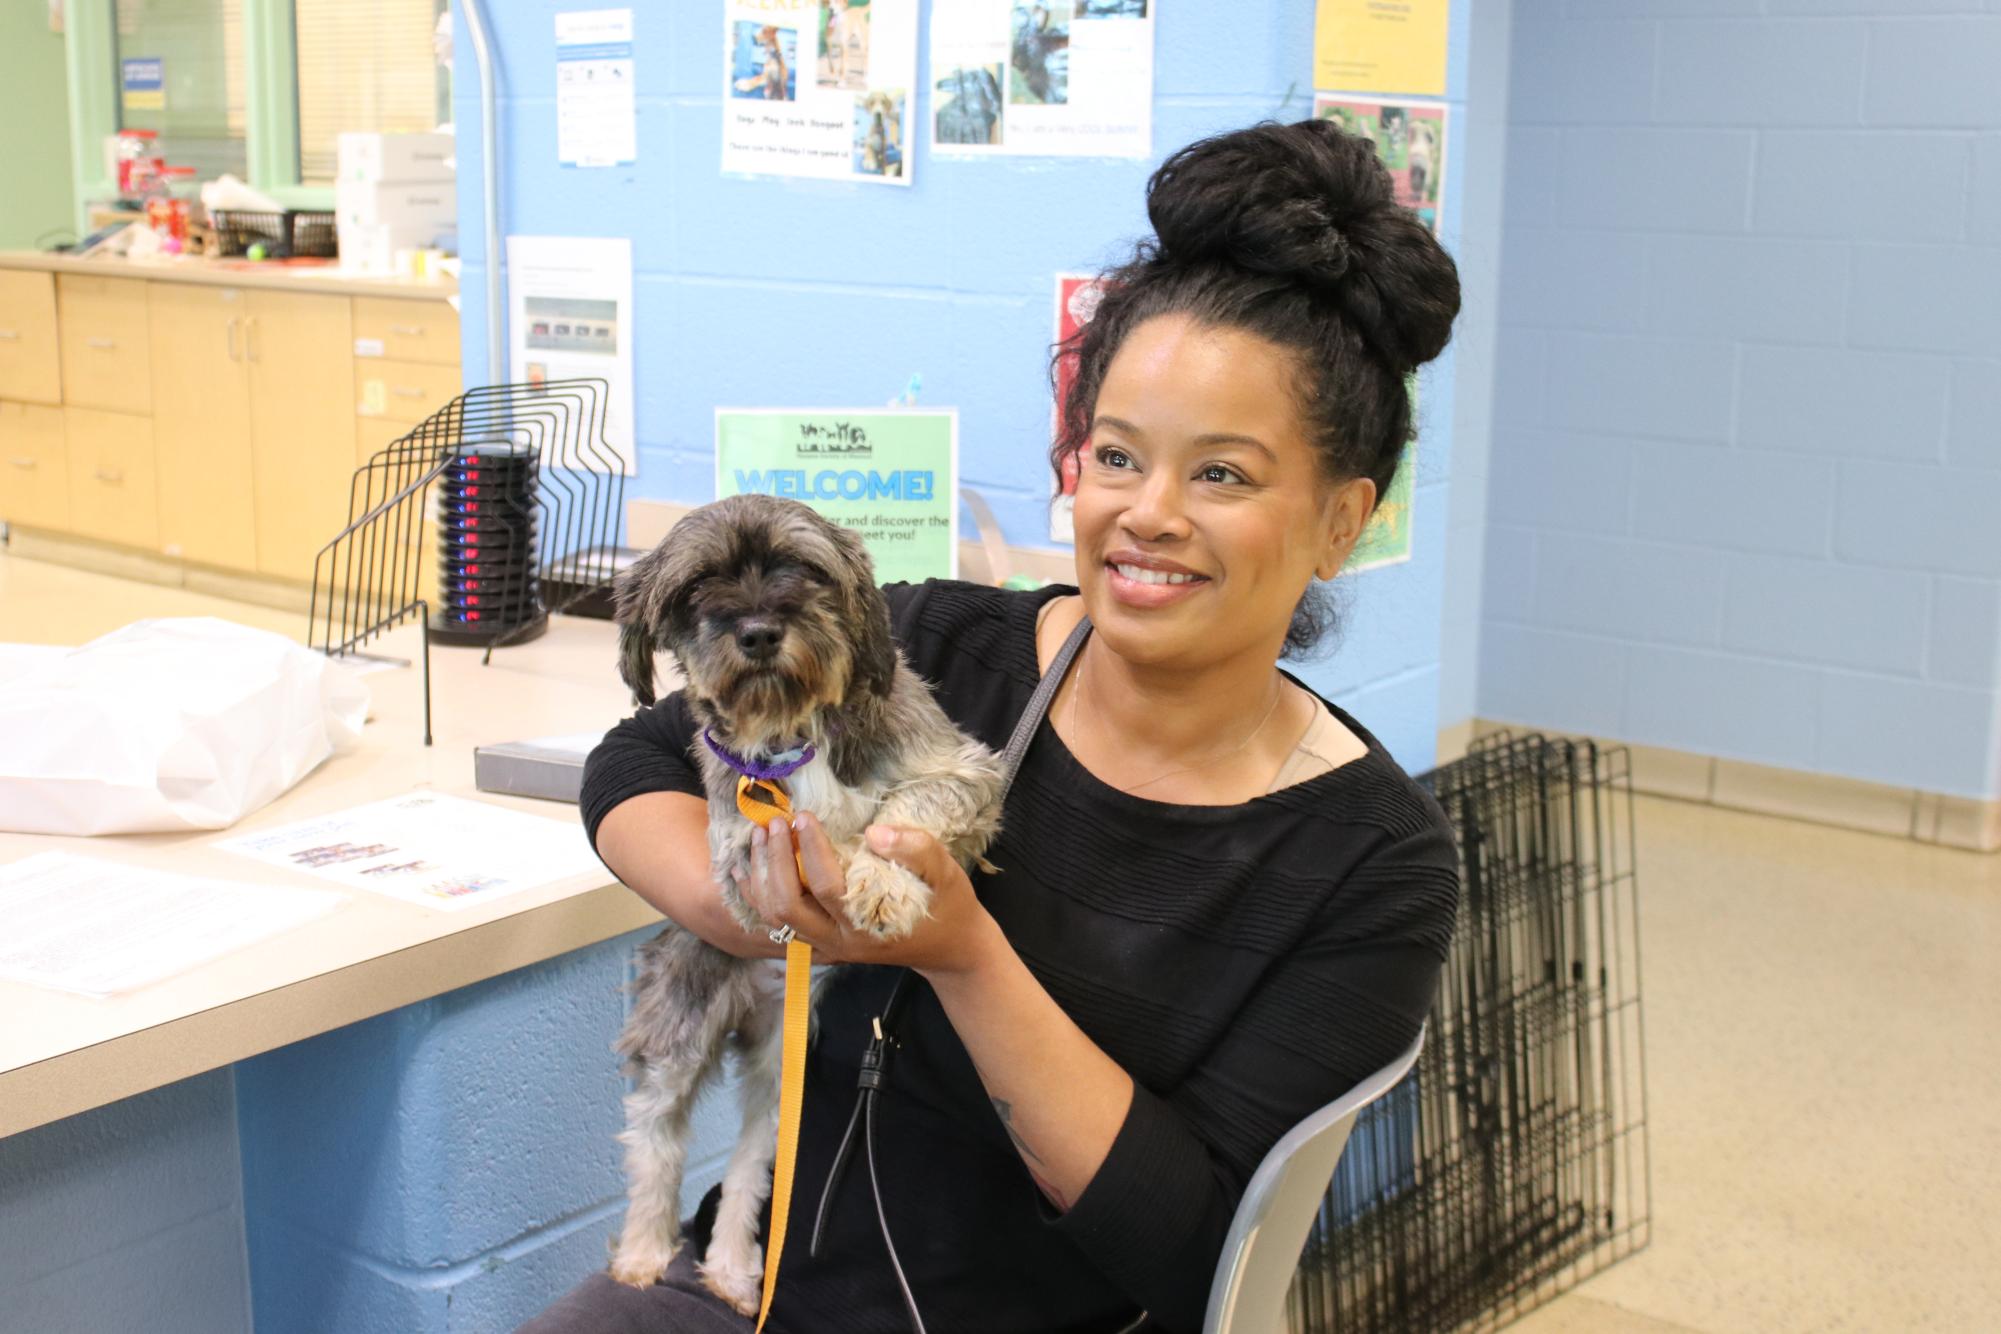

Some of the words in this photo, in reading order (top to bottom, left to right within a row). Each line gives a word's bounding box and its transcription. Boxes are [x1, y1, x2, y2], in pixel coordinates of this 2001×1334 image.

[735, 469, 934, 500] WELCOME!
[845, 514, 868, 527] and
[872, 515, 924, 527] discover
[928, 515, 949, 527] the
[861, 529, 884, 540] eet
[888, 528, 916, 541] you!
